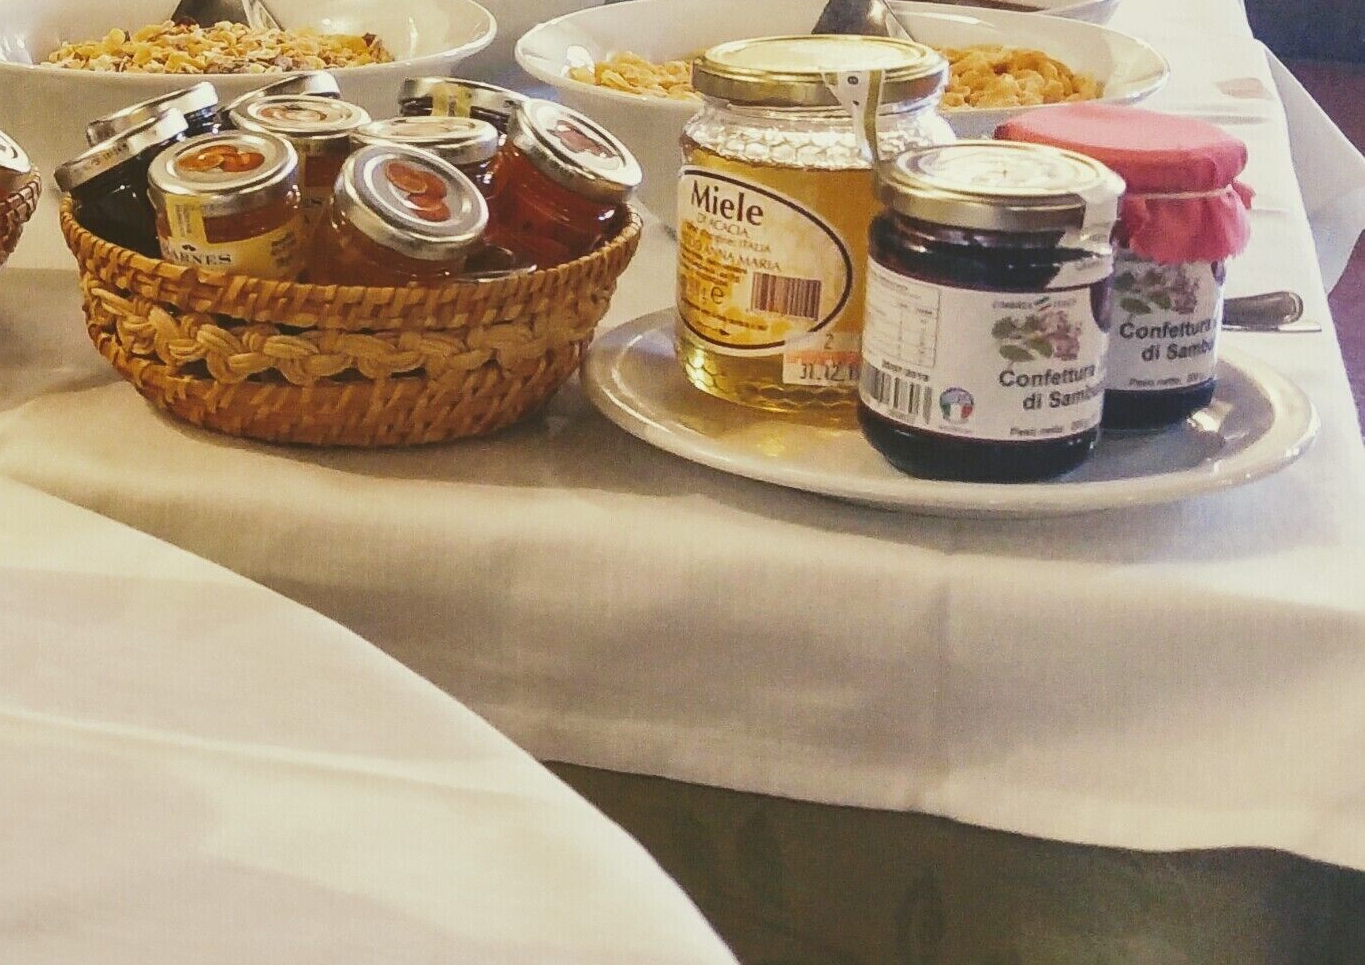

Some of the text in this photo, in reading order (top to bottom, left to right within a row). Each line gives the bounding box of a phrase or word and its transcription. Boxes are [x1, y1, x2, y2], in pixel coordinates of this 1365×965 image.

[691, 179, 764, 226] Miele
[1141, 344, 1161, 362] di
[1022, 392, 1042, 411] di
